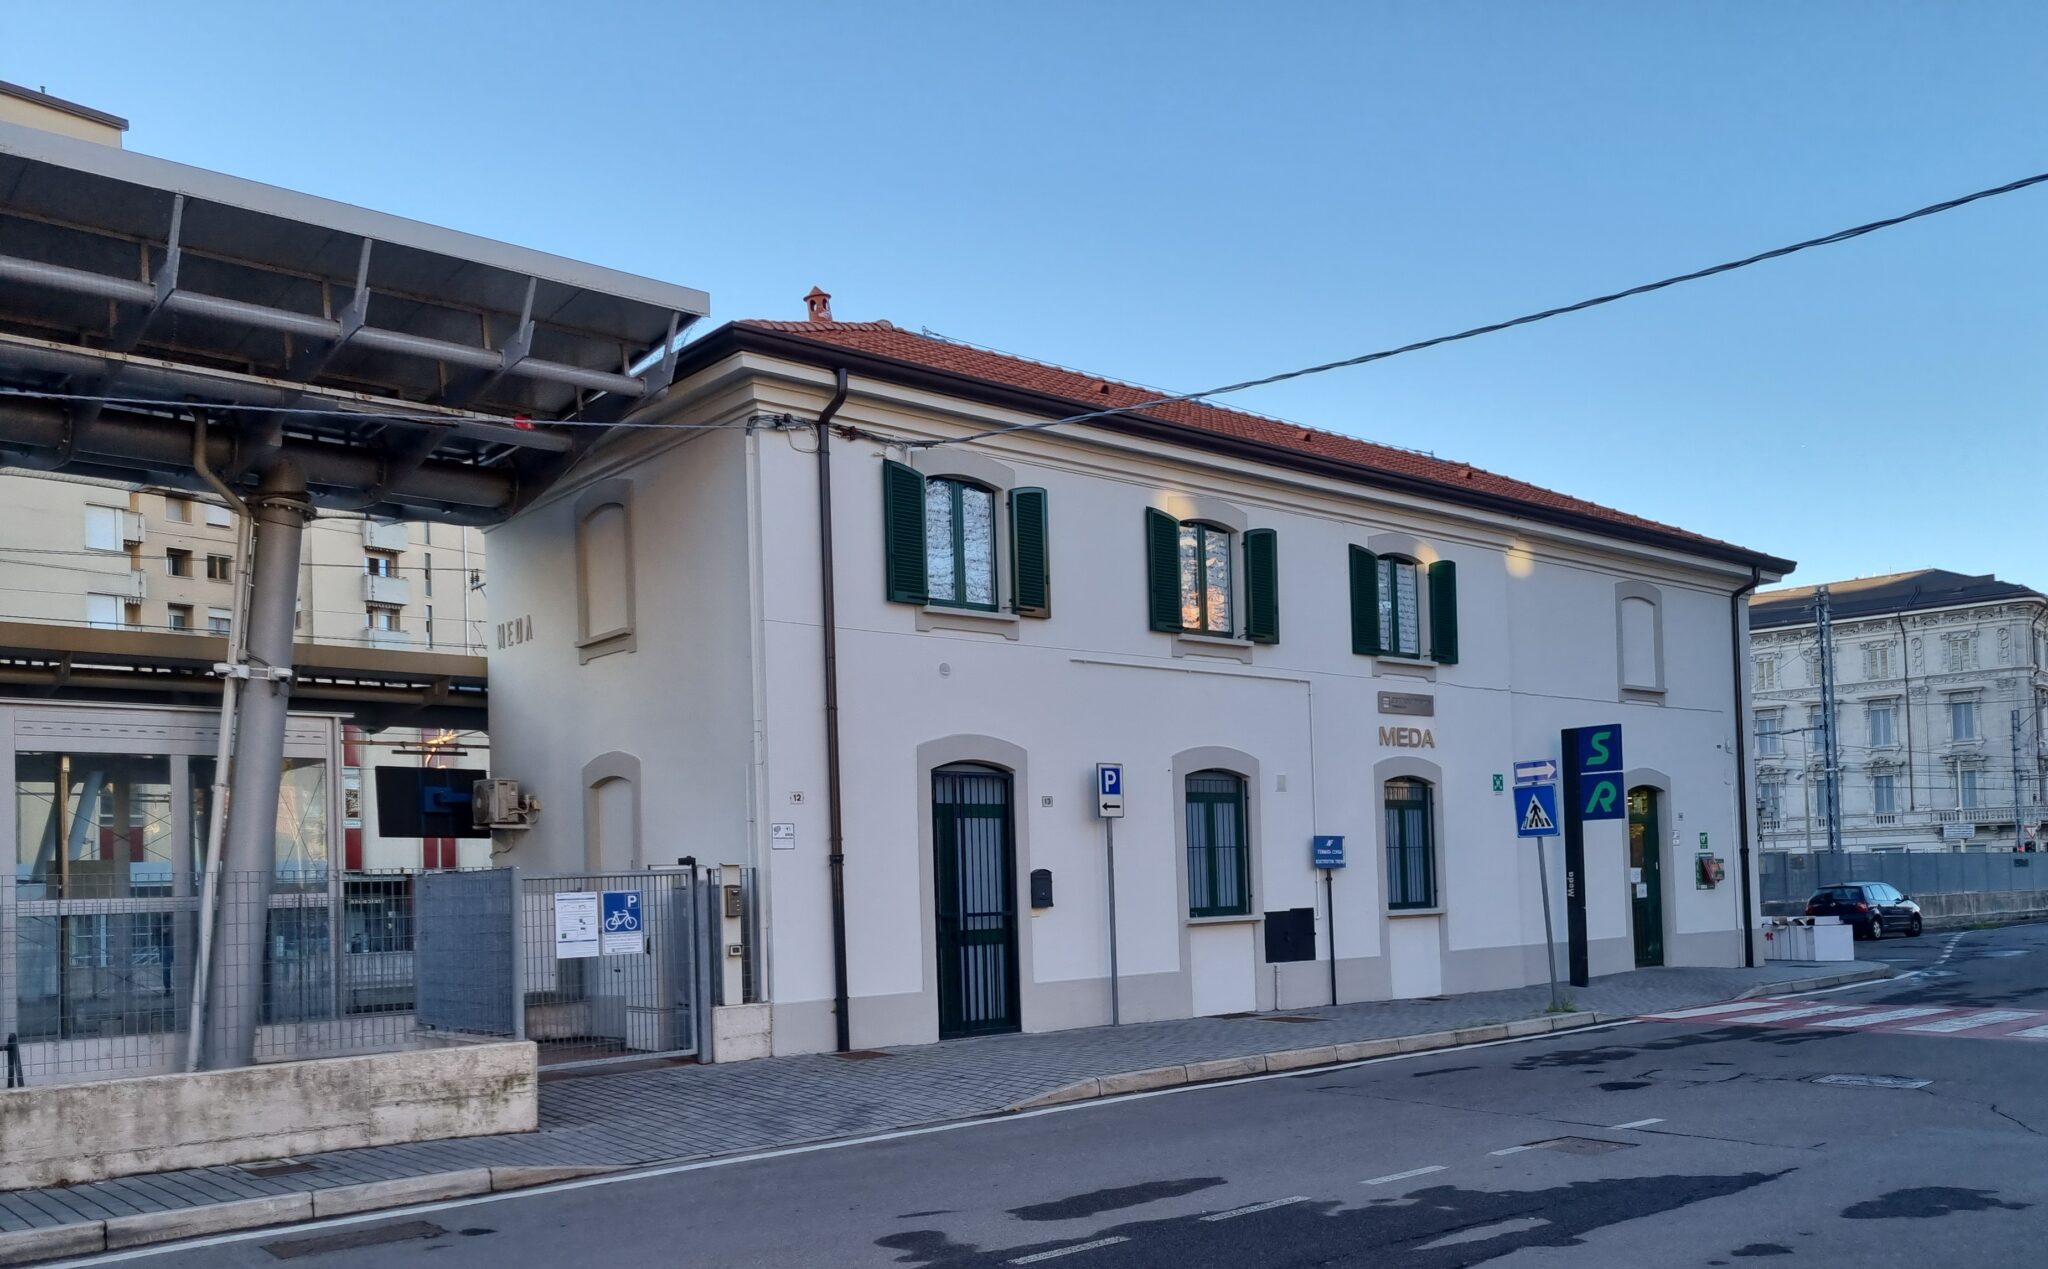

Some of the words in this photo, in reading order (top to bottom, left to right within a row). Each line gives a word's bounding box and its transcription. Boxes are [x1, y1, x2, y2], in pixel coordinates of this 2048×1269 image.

[497, 614, 533, 650] MEDA
[1378, 726, 1435, 748] MEDA
[1586, 731, 1612, 766] S
[1104, 770, 1117, 793] P
[793, 793, 802, 802] 12
[1585, 780, 1617, 813] R
[1567, 871, 1575, 897] Meda
[627, 895, 638, 907] P
